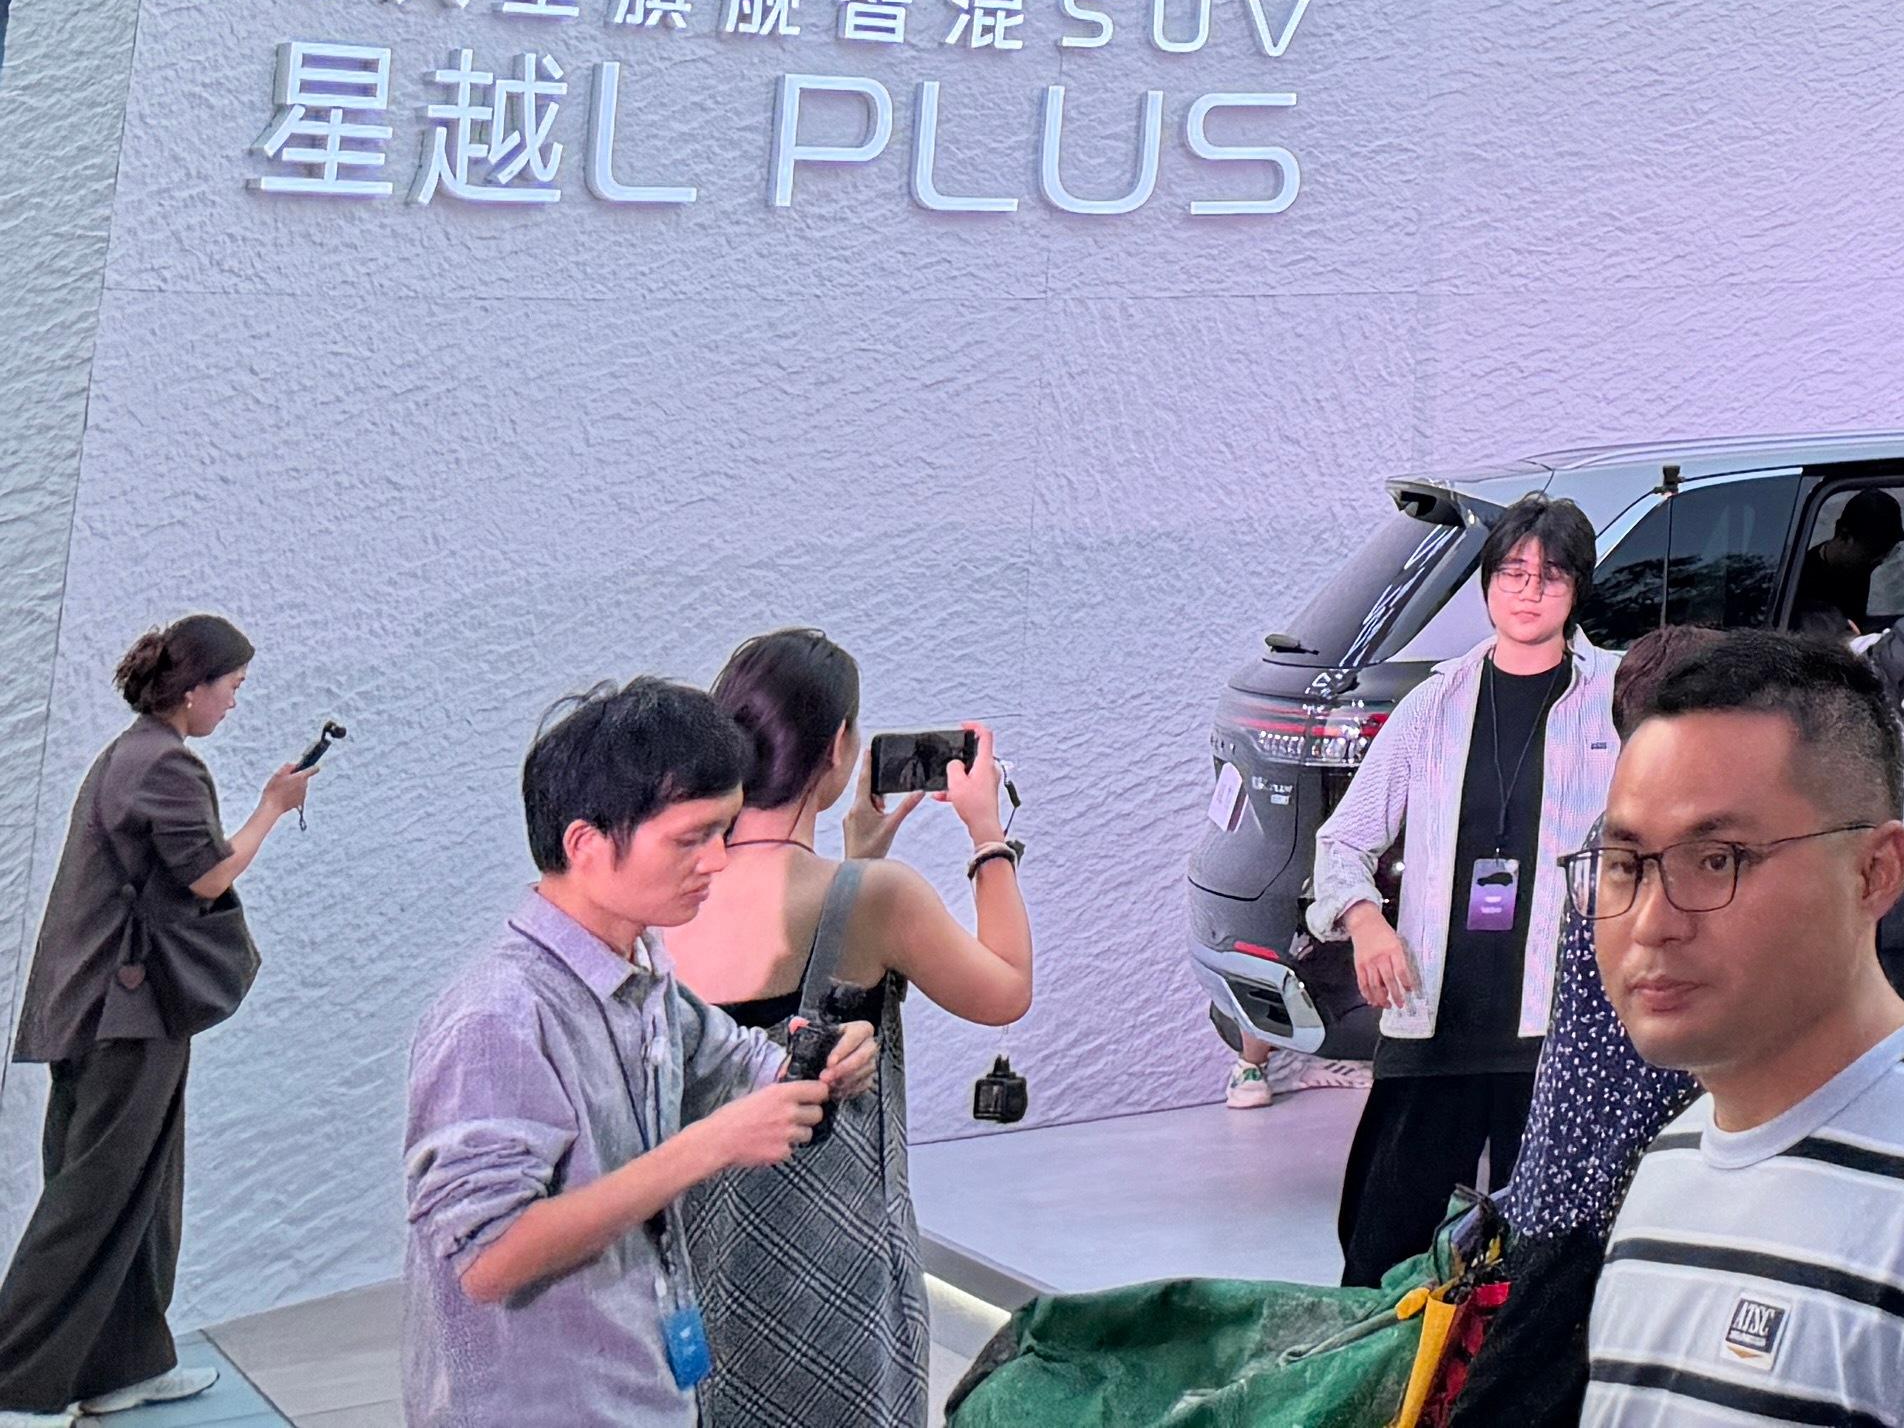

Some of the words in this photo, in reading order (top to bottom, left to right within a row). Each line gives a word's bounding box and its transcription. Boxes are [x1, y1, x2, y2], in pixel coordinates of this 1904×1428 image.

[250, 40, 698, 208] 星越L
[770, 72, 1301, 216] PLUS
[1732, 1301, 1776, 1337] ATSC
